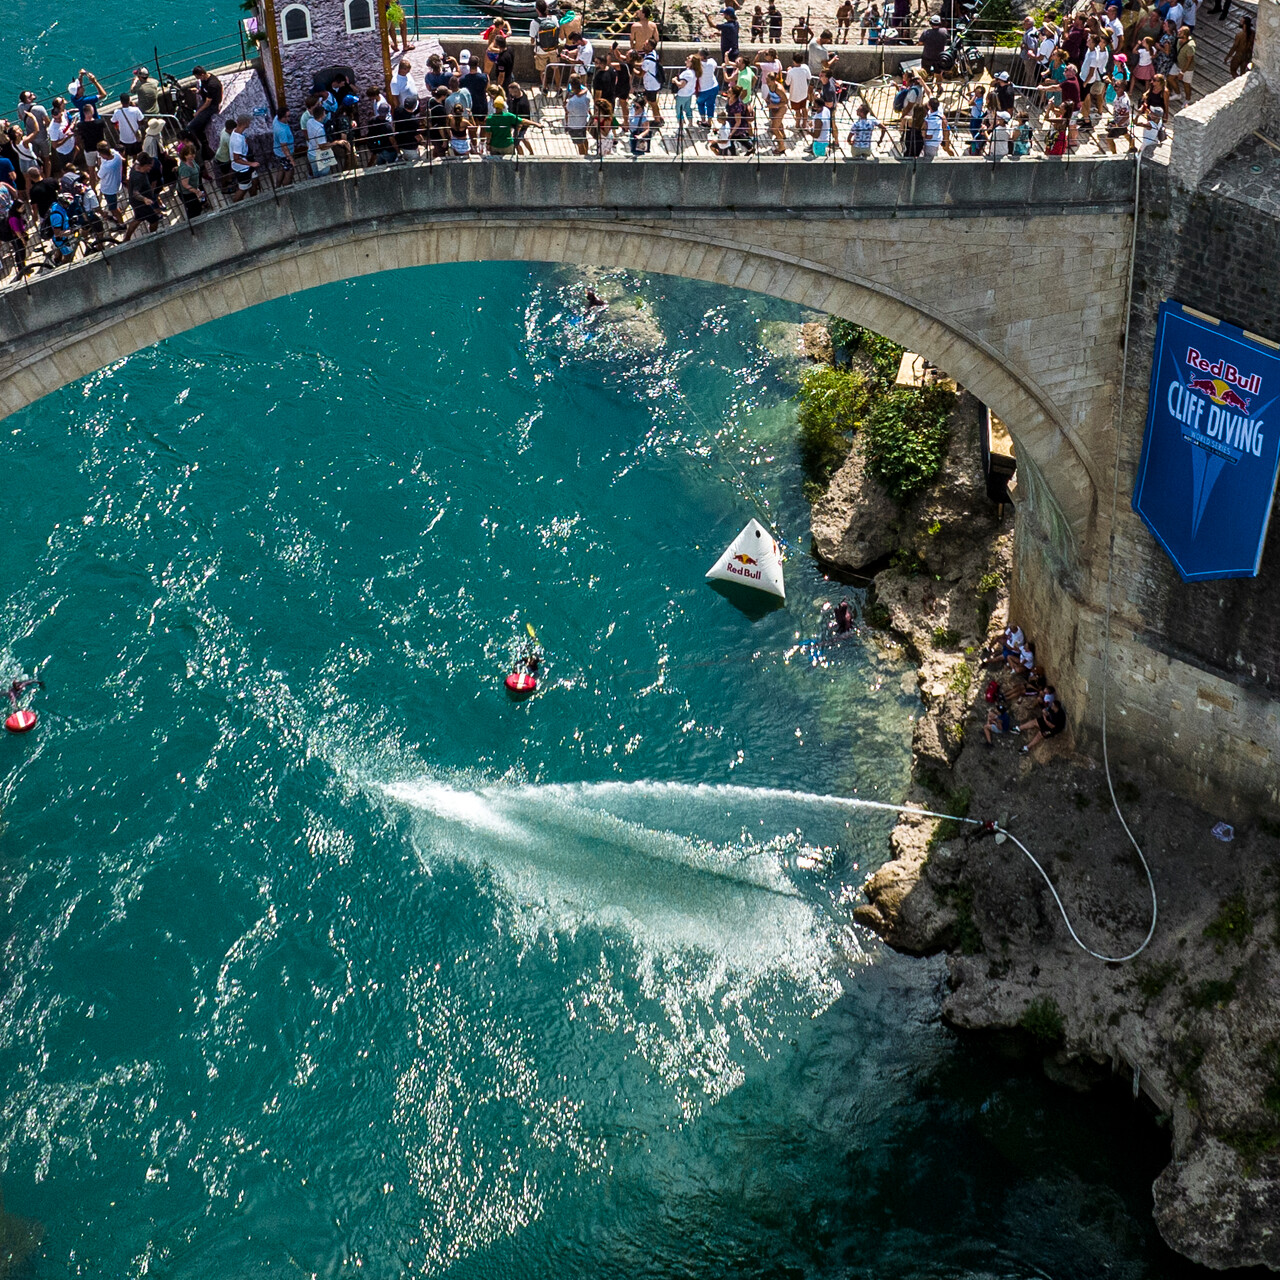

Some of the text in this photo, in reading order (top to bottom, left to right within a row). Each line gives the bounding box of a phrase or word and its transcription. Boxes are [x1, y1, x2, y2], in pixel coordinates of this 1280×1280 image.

[1185, 346, 1262, 396] Red Bull
[1168, 380, 1205, 430] CLIFF
[1206, 405, 1264, 457] DIVING
[726, 563, 762, 580] Red Bull
